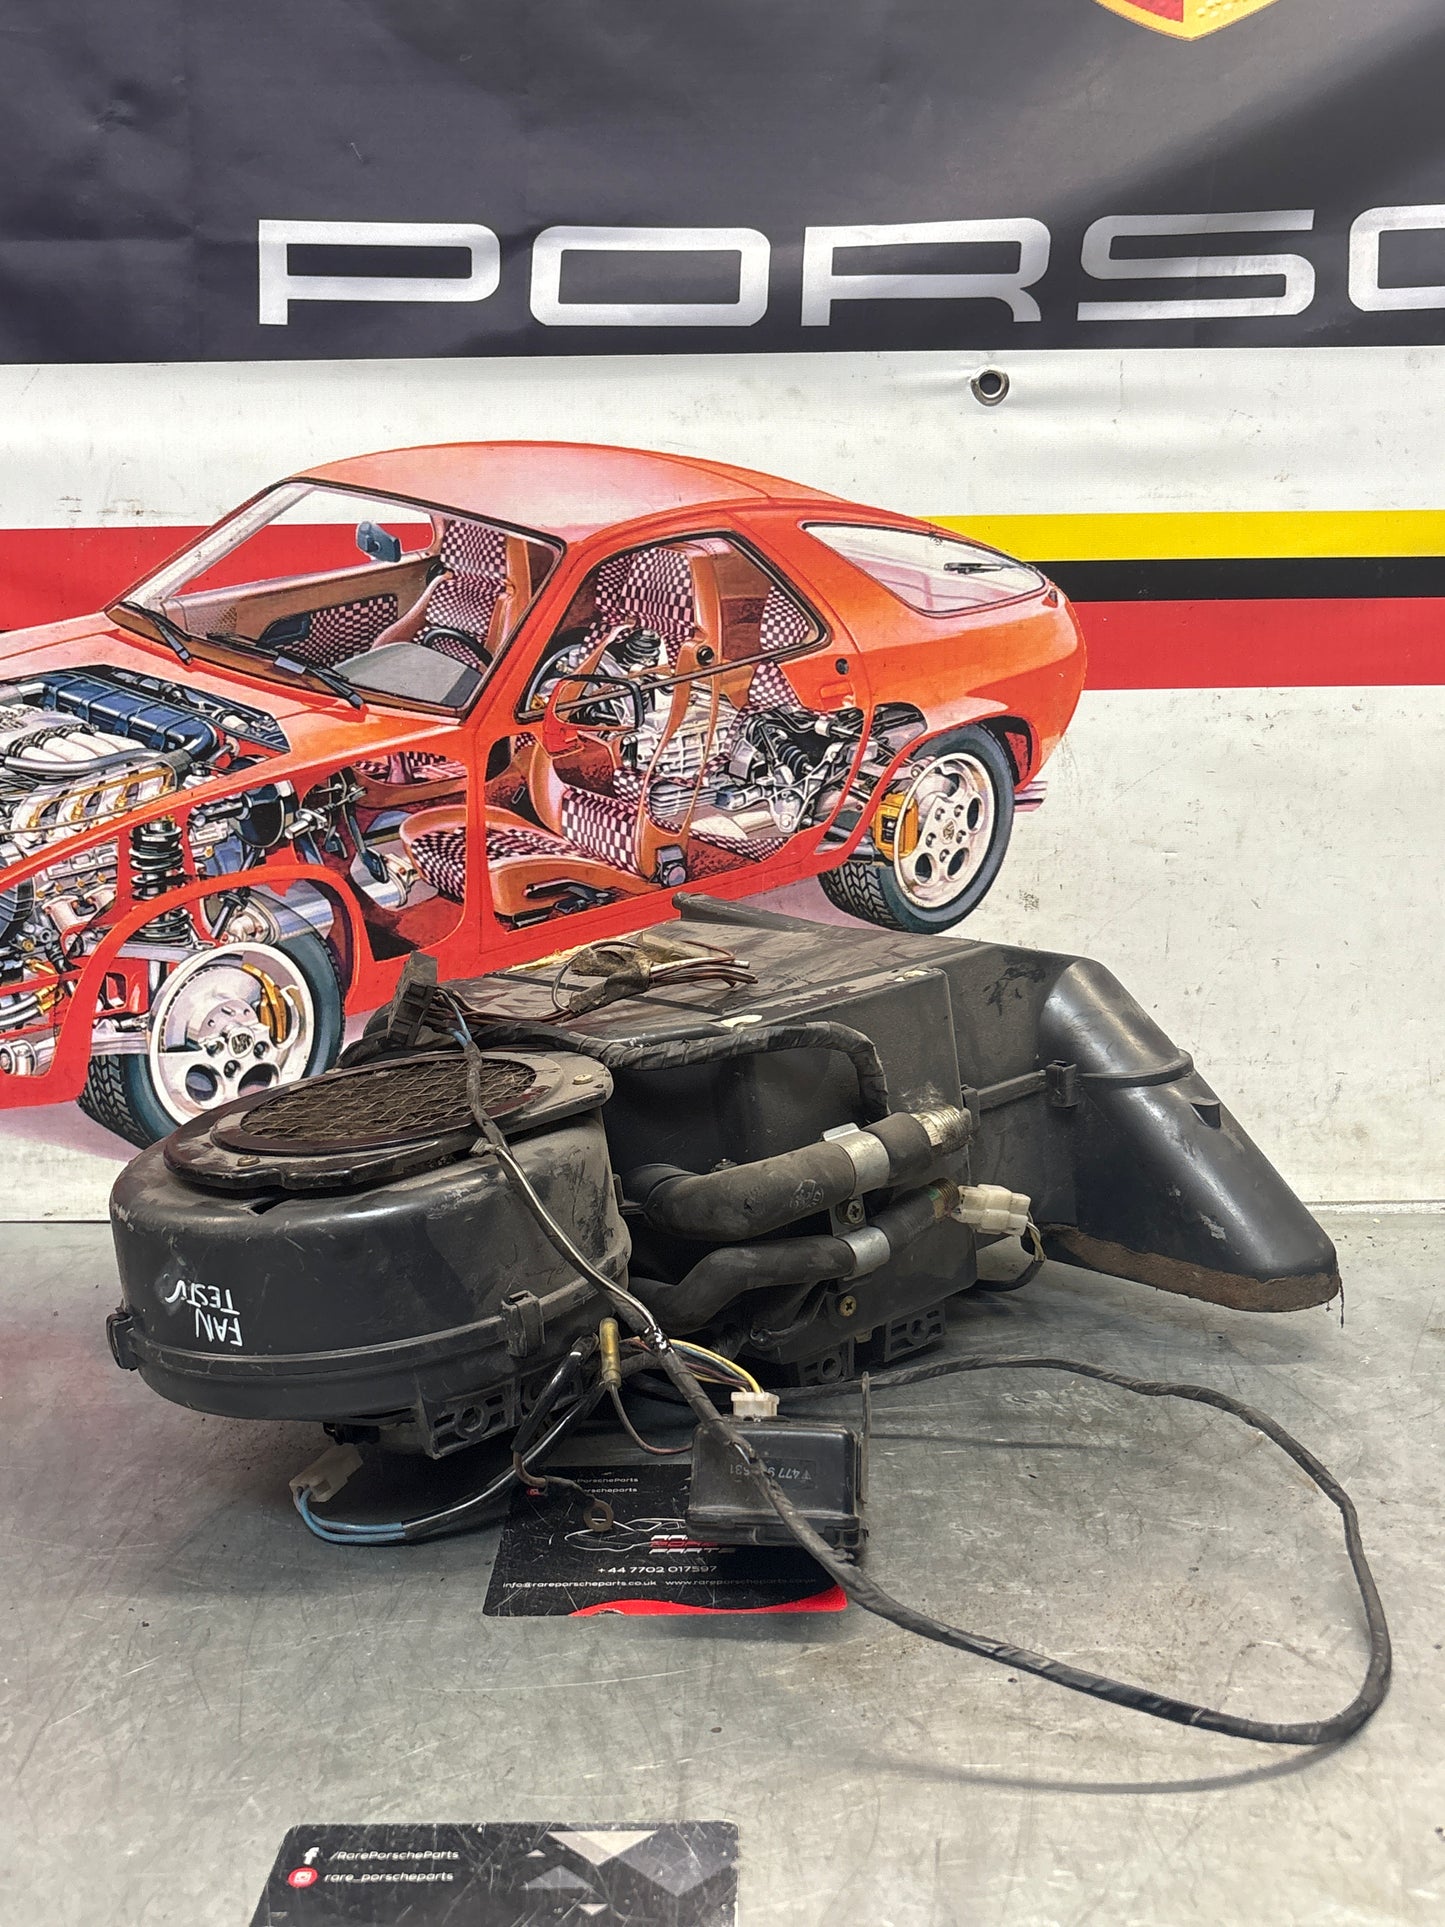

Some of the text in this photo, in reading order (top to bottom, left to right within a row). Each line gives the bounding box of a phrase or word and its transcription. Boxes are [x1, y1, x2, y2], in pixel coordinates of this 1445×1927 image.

[186, 1283, 241, 1315] TEST
[195, 1308, 243, 1346] FAN
[778, 1467, 800, 1479] 477
[597, 1565, 717, 1574] +44 7702 017597
[324, 1871, 454, 1884] rare_porscheparts
